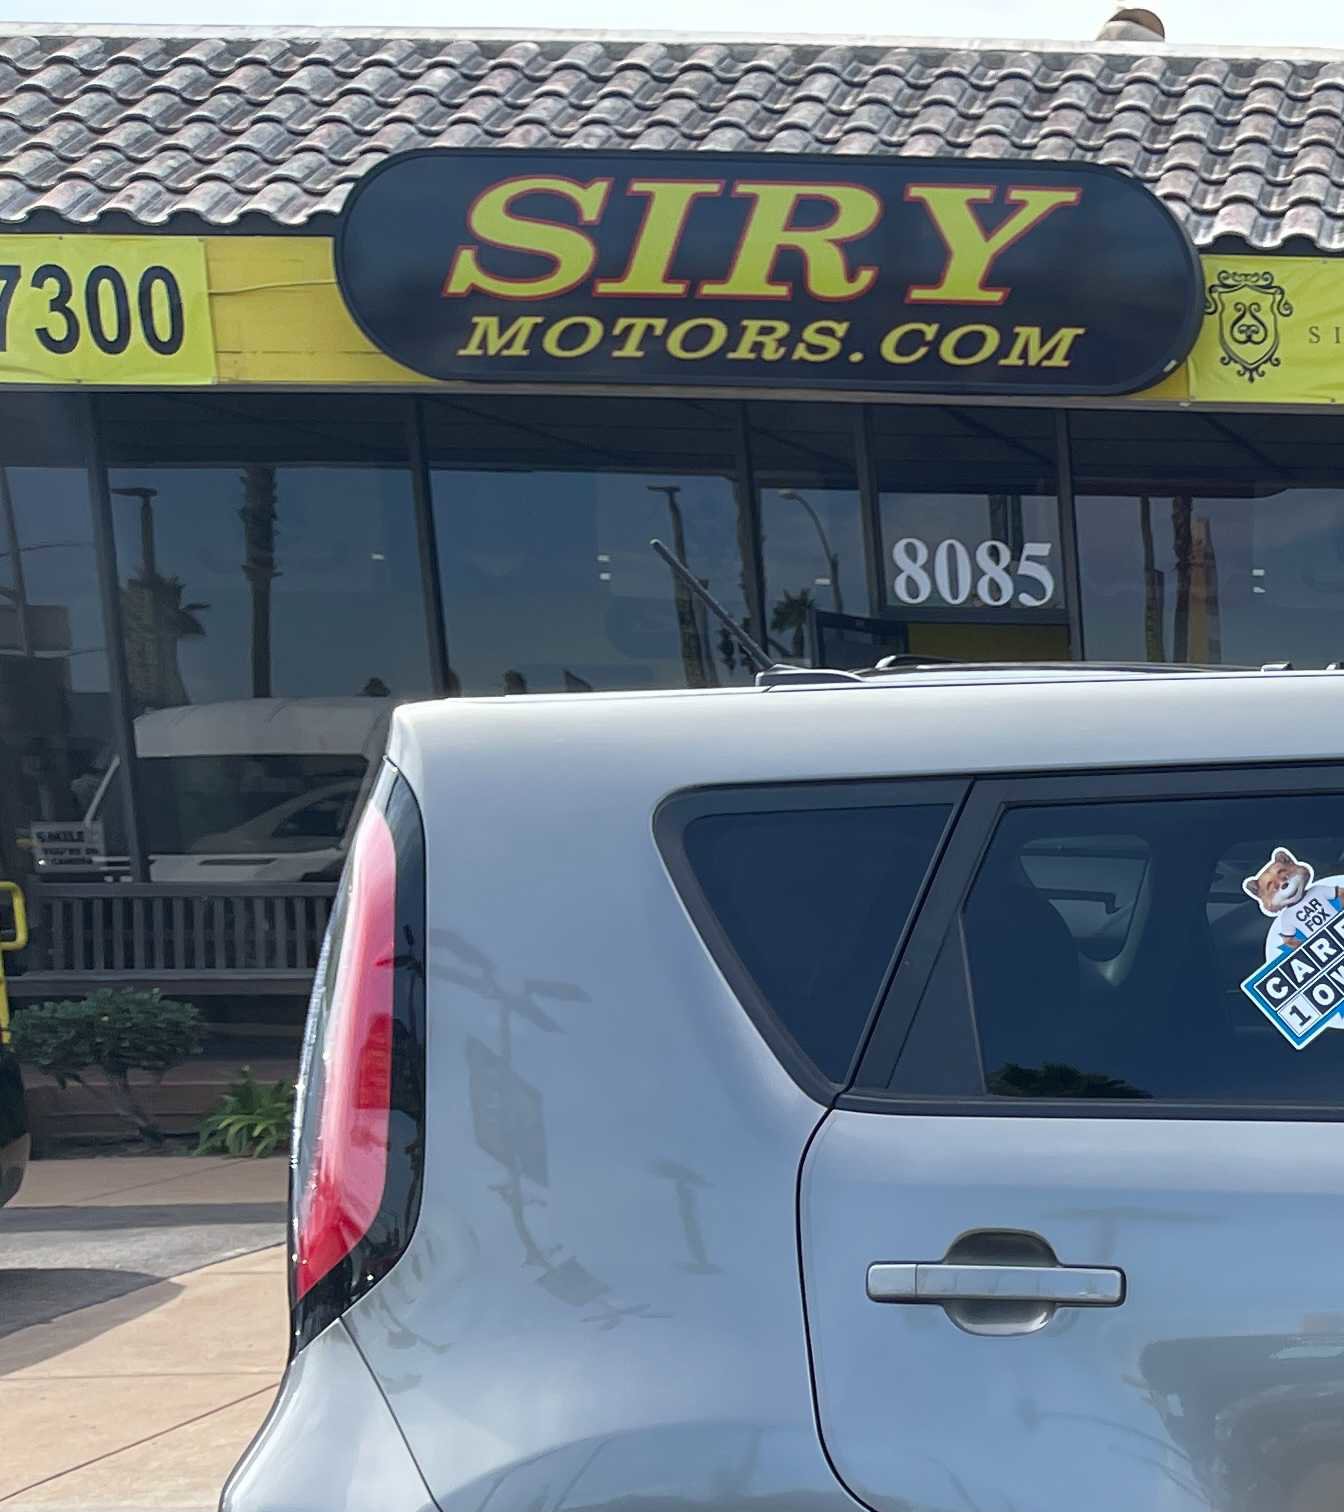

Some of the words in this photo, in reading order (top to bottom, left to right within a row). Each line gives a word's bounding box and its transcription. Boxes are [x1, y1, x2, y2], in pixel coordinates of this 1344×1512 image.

[444, 176, 1080, 306] SIRY
[458, 313, 1086, 368] MOTORS.COM
[892, 537, 1057, 608] 8085
[1295, 898, 1322, 922] CAR
[1304, 909, 1331, 932] FOX
[1289, 1004, 1311, 1027] 1
